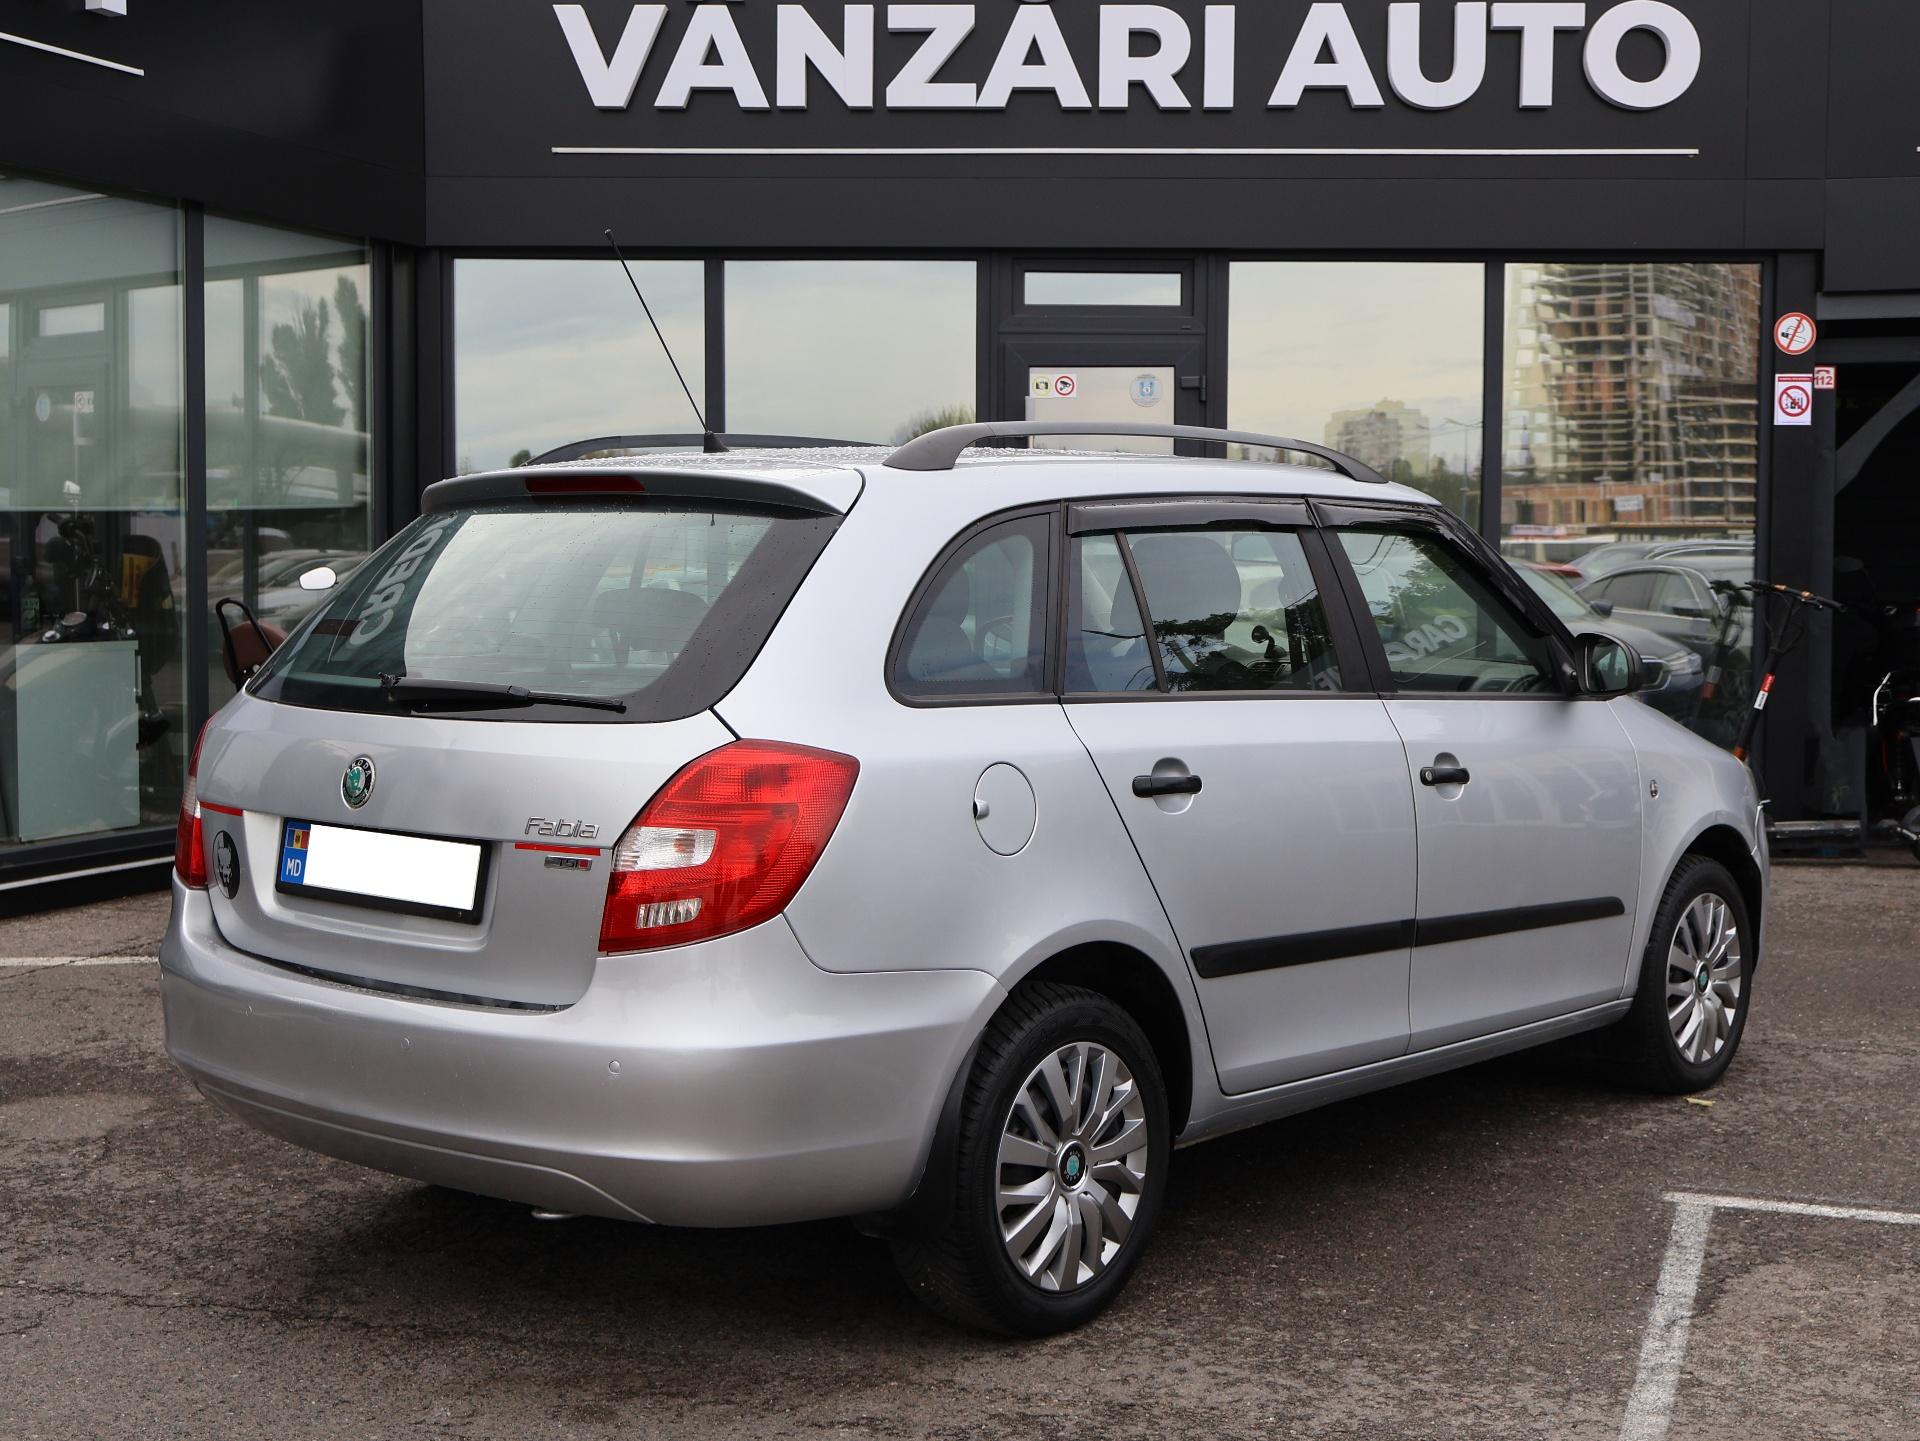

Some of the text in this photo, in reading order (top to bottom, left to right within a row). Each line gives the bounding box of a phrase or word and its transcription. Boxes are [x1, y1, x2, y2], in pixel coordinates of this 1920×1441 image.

[1266, 0, 1701, 111] AUTO
[1815, 375, 1833, 386] 112
[524, 816, 600, 840] Fabia
[285, 857, 302, 877] MD
